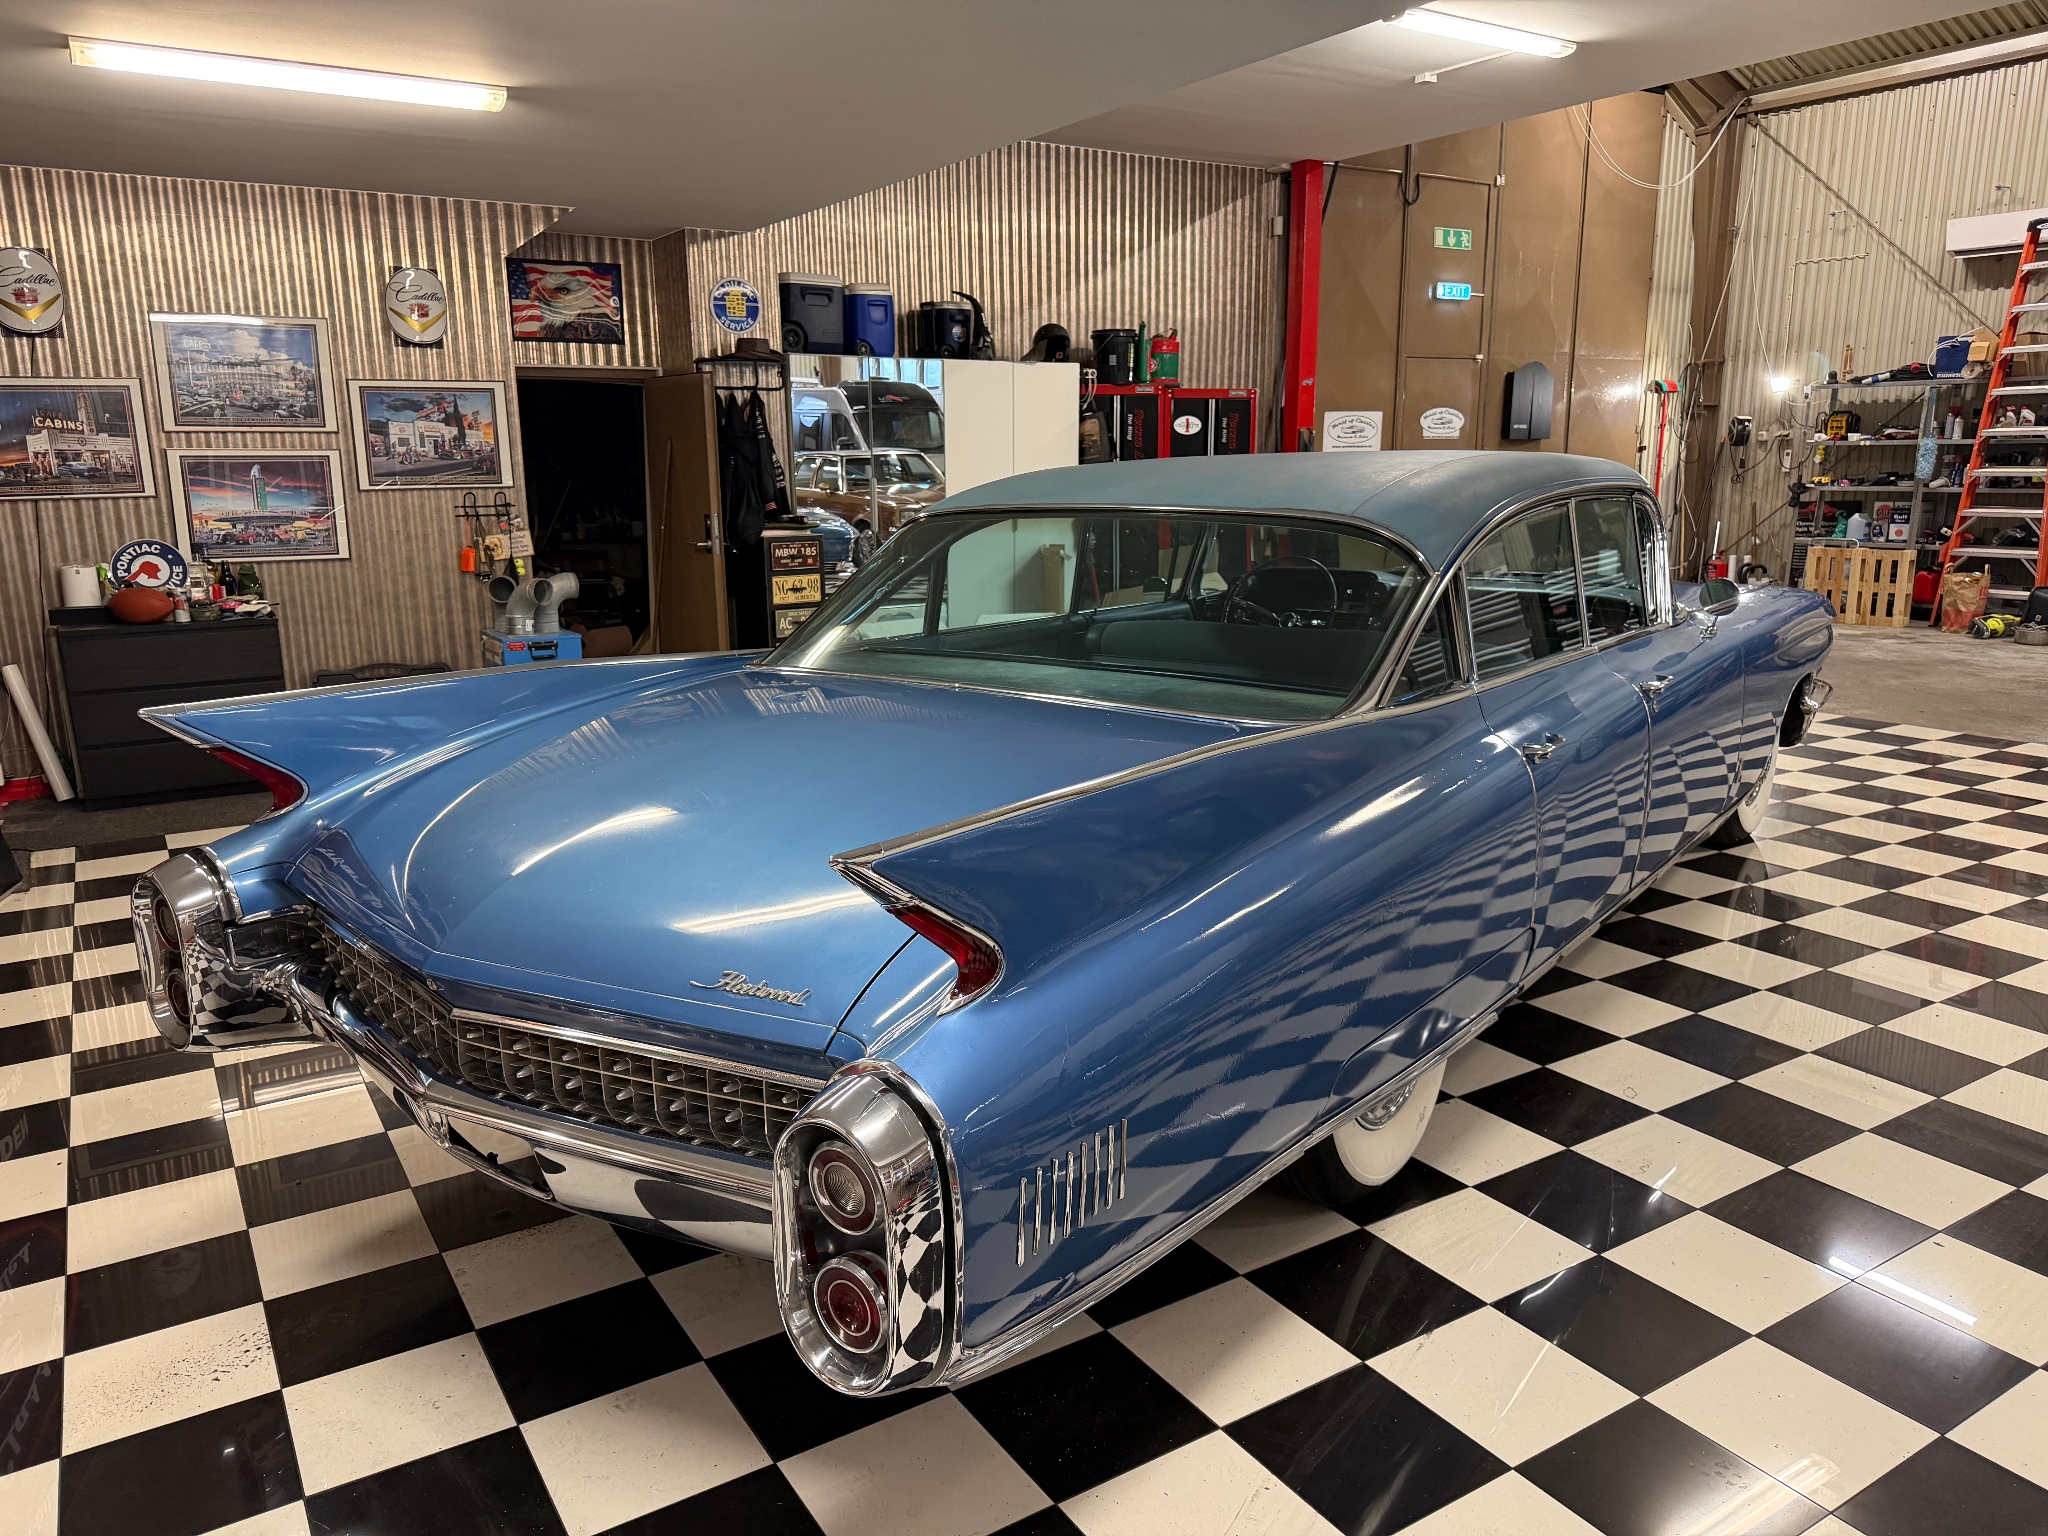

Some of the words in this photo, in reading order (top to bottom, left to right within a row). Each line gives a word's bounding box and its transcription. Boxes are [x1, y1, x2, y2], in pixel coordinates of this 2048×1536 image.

[0, 266, 57, 287] Cadillac
[389, 282, 445, 304] Cadillac
[1442, 285, 1469, 298] EXIT
[720, 316, 754, 330] SERVICE
[35, 417, 83, 430] CABINS
[1331, 419, 1347, 429] World
[775, 547, 798, 557] MBW
[800, 547, 817, 556] 185
[116, 543, 161, 578] PONTIAC
[807, 578, 819, 593] 98
[780, 617, 793, 629] AC
[688, 970, 812, 1006] Fleetwood
